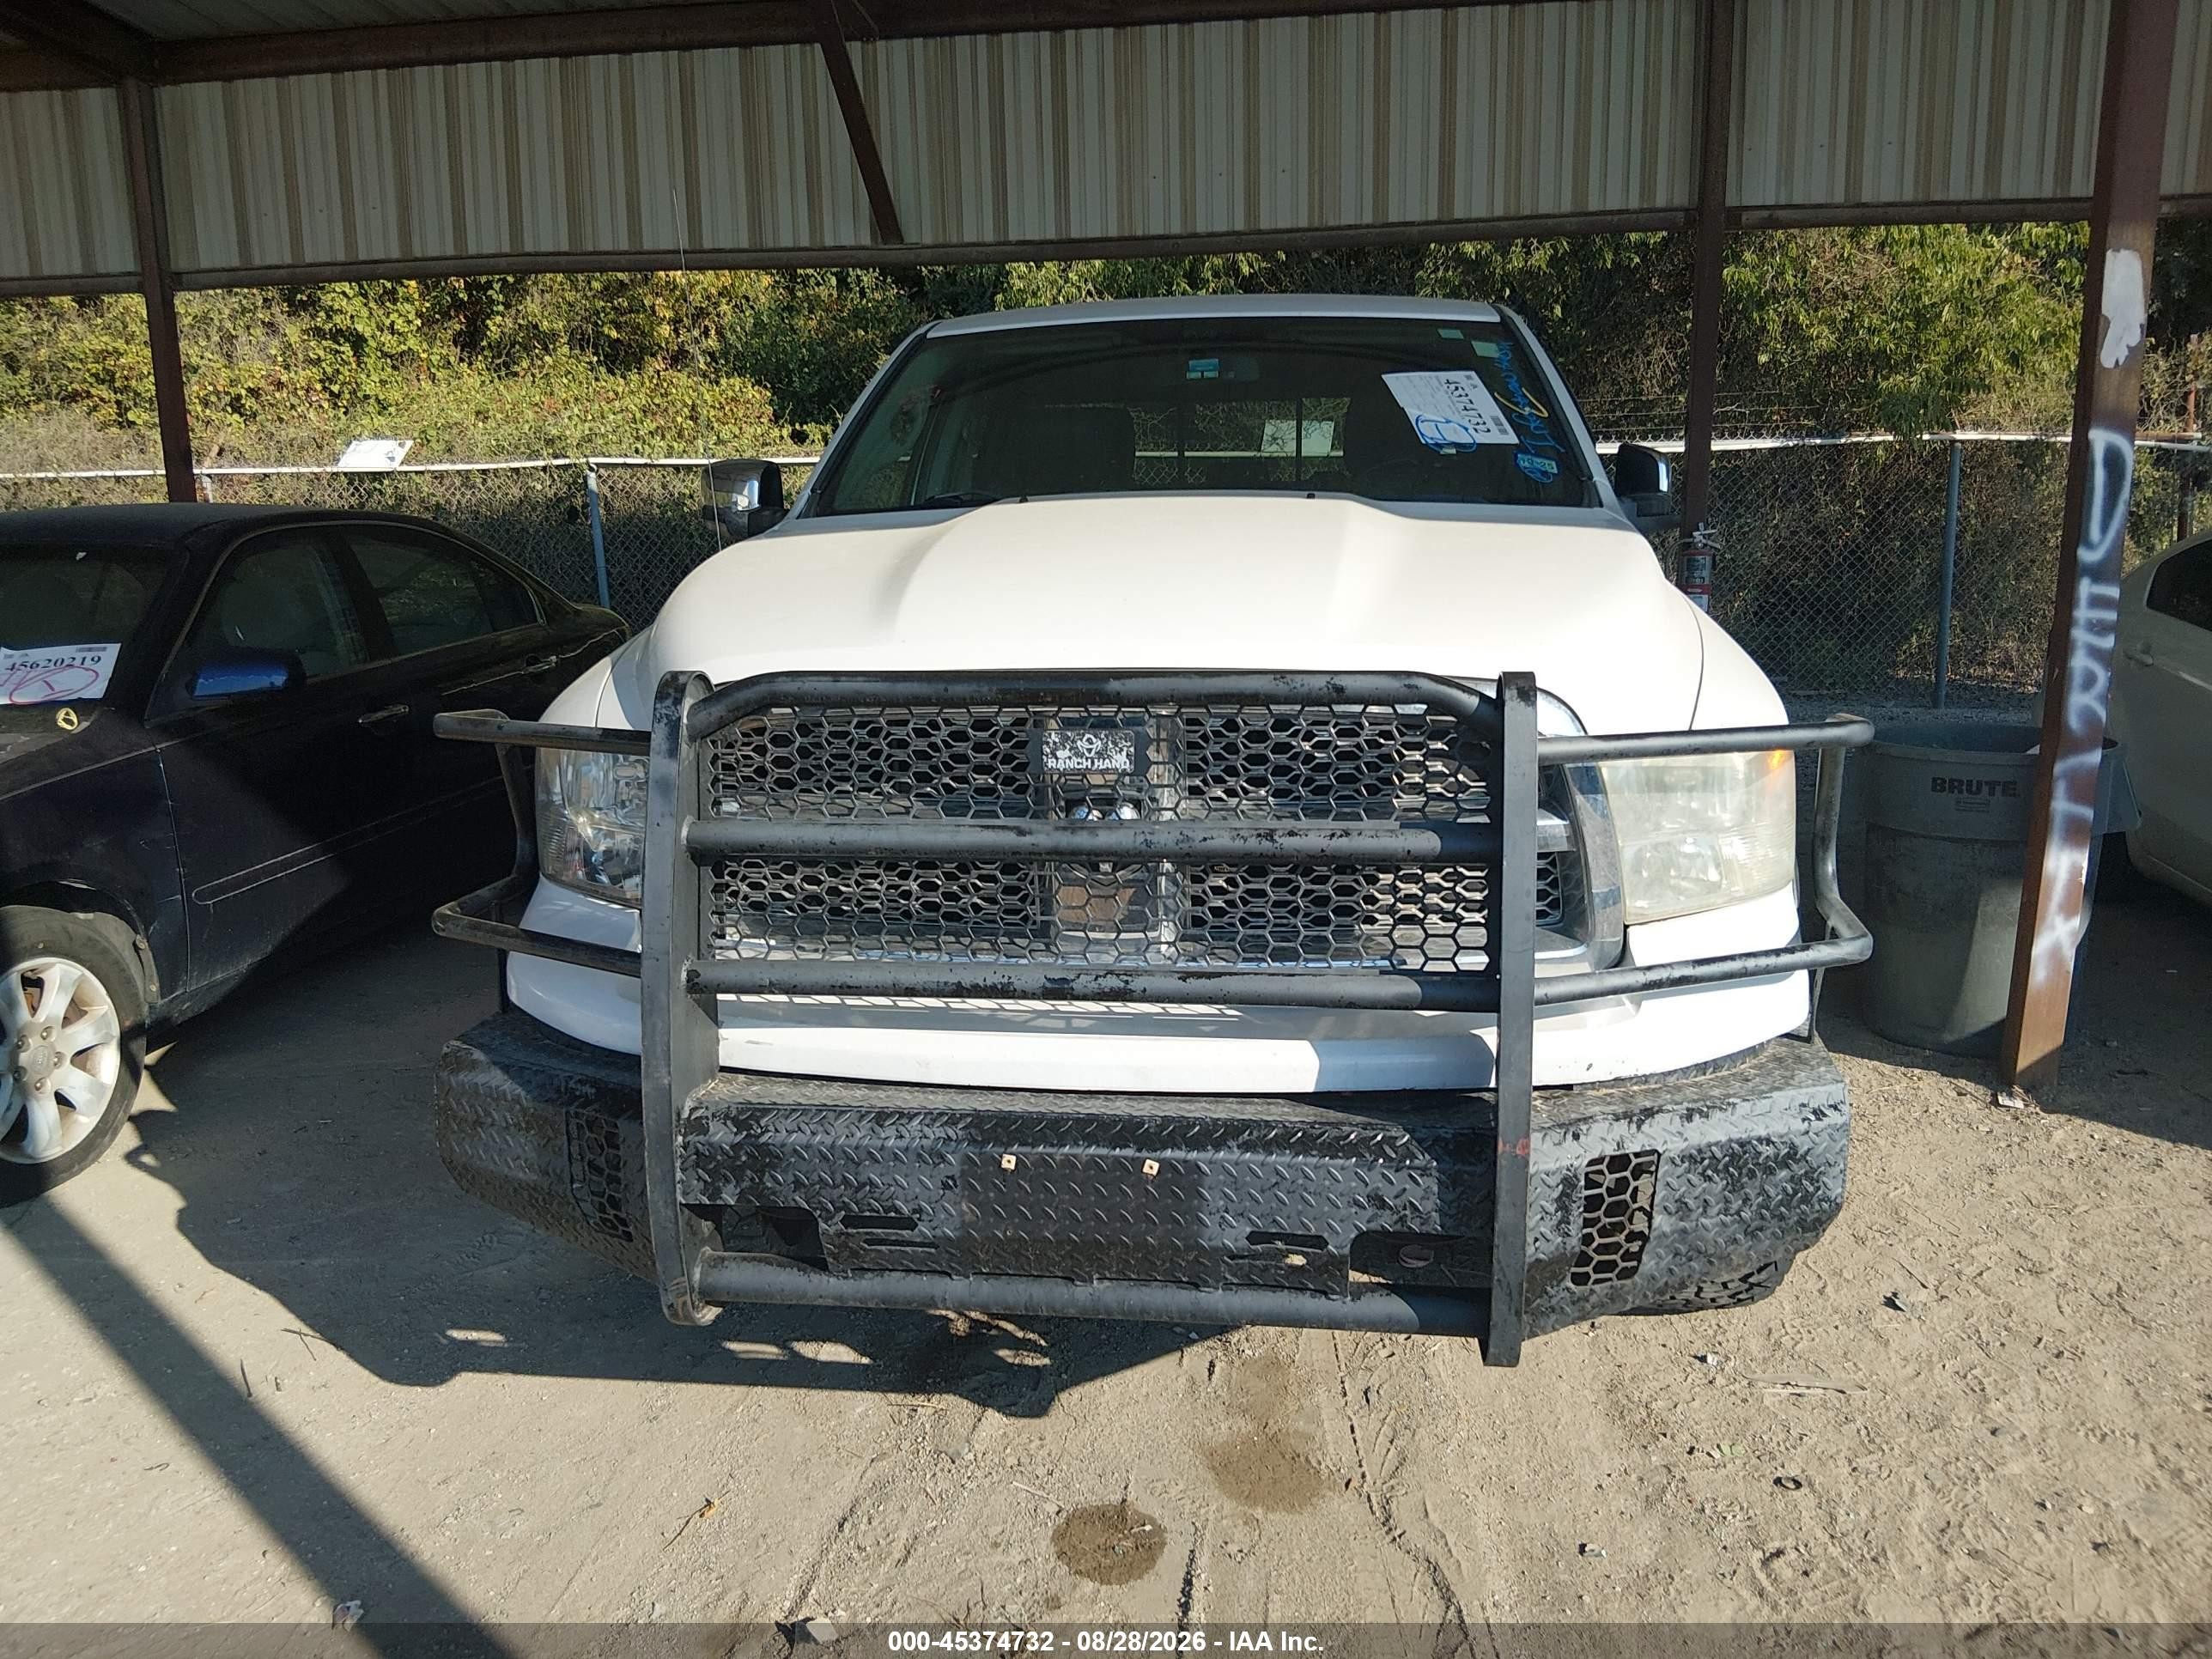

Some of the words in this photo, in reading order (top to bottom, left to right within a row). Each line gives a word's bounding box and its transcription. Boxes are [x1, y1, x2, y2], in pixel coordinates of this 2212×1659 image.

[1444, 378, 1492, 434] 45374732
[4, 655, 102, 673] 45620219
[1048, 757, 1091, 769] RANCH
[1094, 757, 1130, 769] HAND
[1931, 776, 2018, 797] BRUTE
